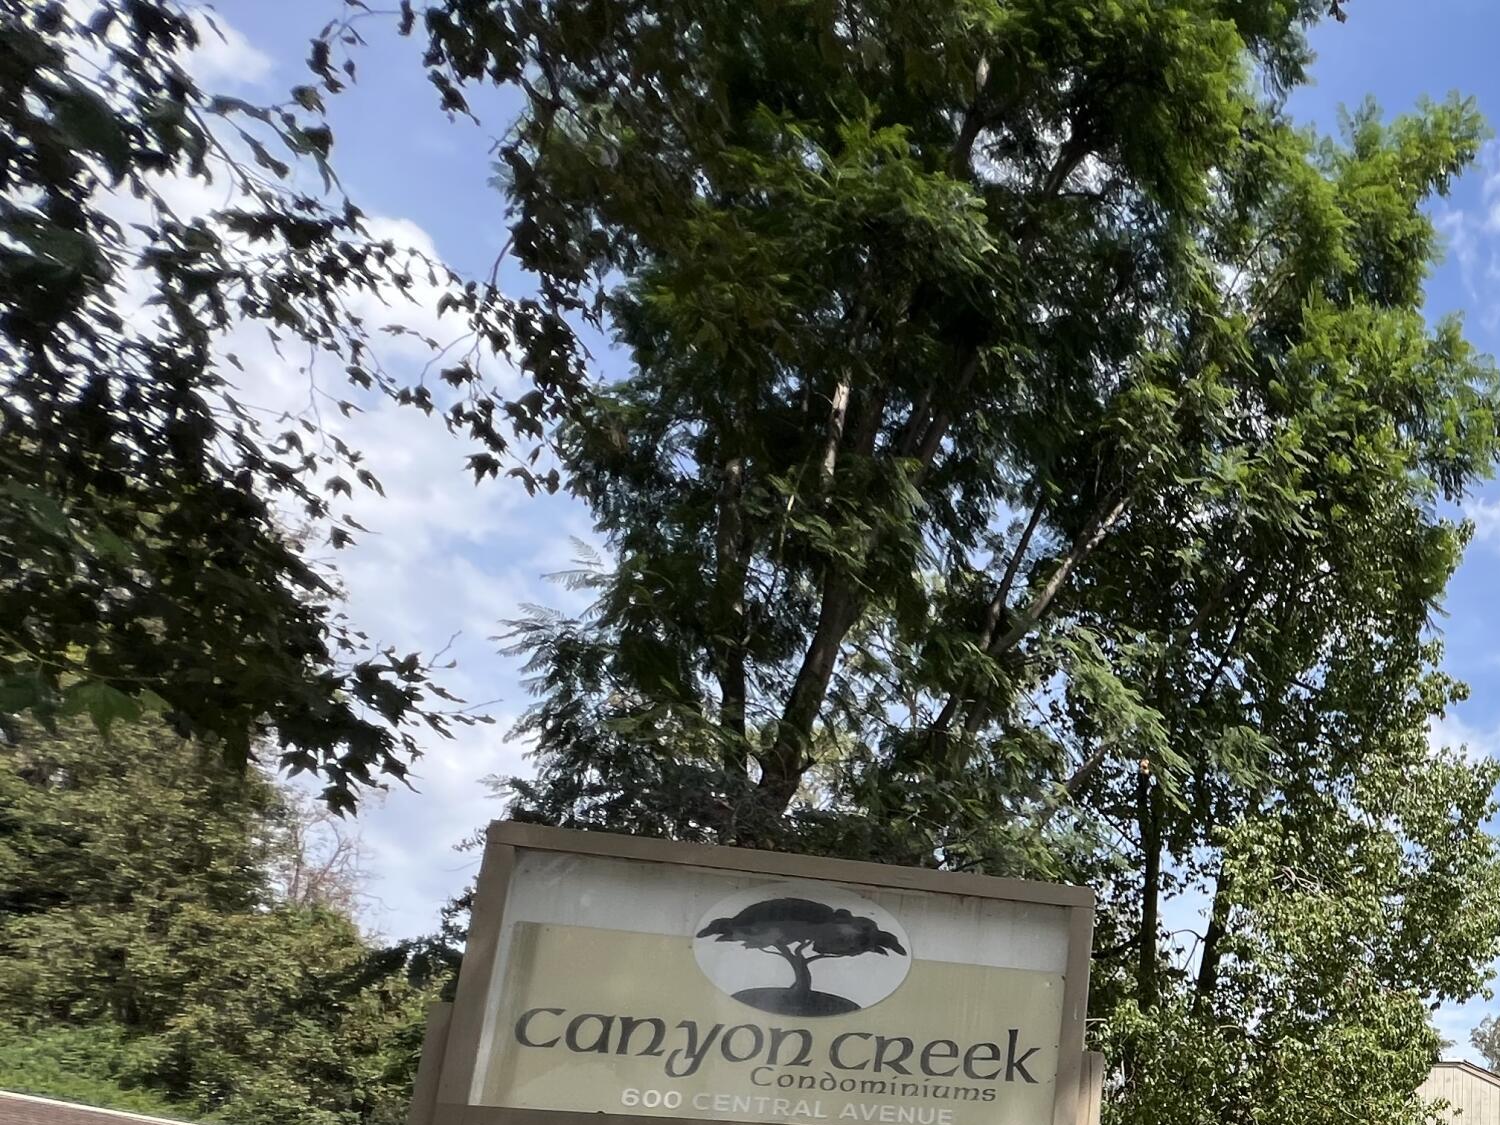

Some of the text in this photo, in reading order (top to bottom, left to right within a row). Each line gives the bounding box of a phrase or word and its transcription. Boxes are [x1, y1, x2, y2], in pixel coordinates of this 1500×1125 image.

[750, 1066, 997, 1102] Condominiums
[621, 1087, 953, 1125] 600 CENTRAL AVENUE
